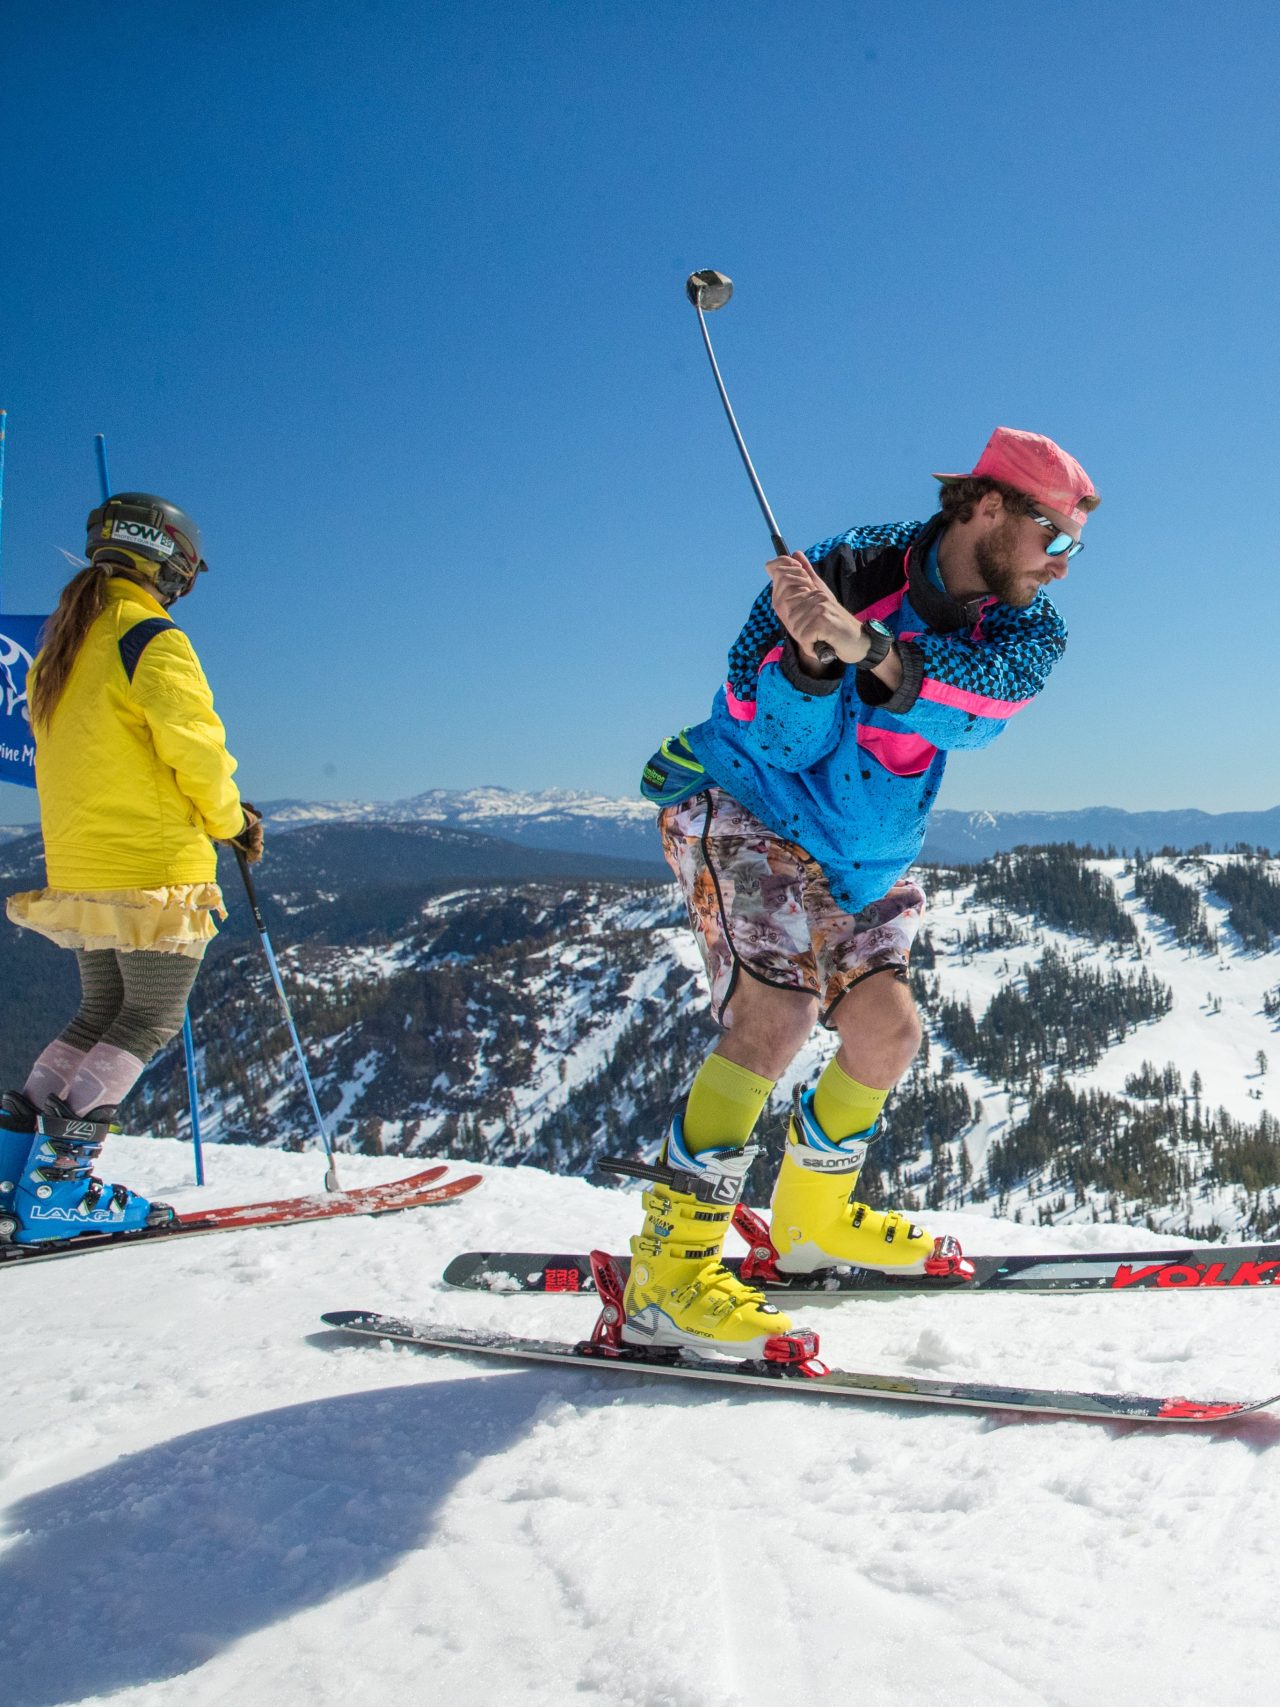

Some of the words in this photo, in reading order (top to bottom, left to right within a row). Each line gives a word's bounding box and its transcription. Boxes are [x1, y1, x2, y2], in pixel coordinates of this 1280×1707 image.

[116, 521, 162, 542] POW
[0, 743, 20, 763] ine
[30, 1205, 126, 1223] LANGE
